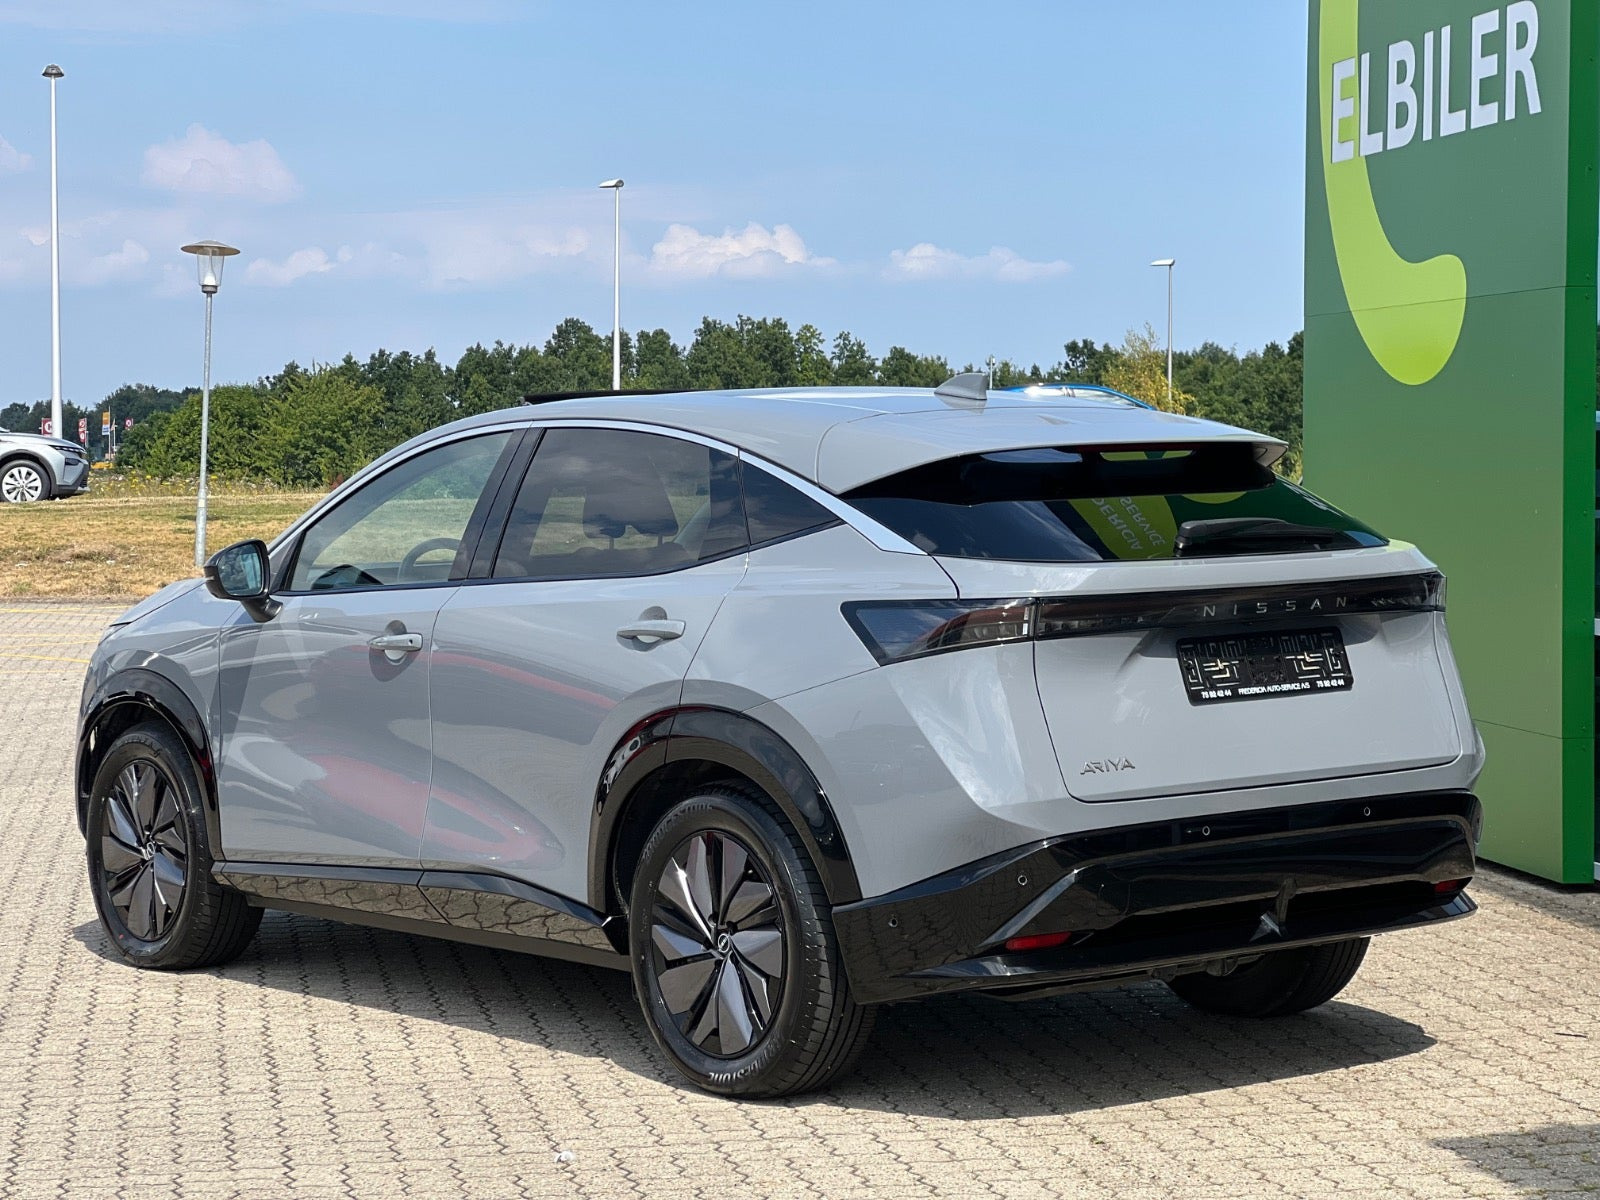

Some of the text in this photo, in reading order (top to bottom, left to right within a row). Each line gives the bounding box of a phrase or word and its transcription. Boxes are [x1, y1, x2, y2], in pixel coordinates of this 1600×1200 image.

[1331, 0, 1542, 164] ELBILER
[1203, 597, 1347, 617] NISSAN
[1080, 757, 1136, 775] ARIYA
